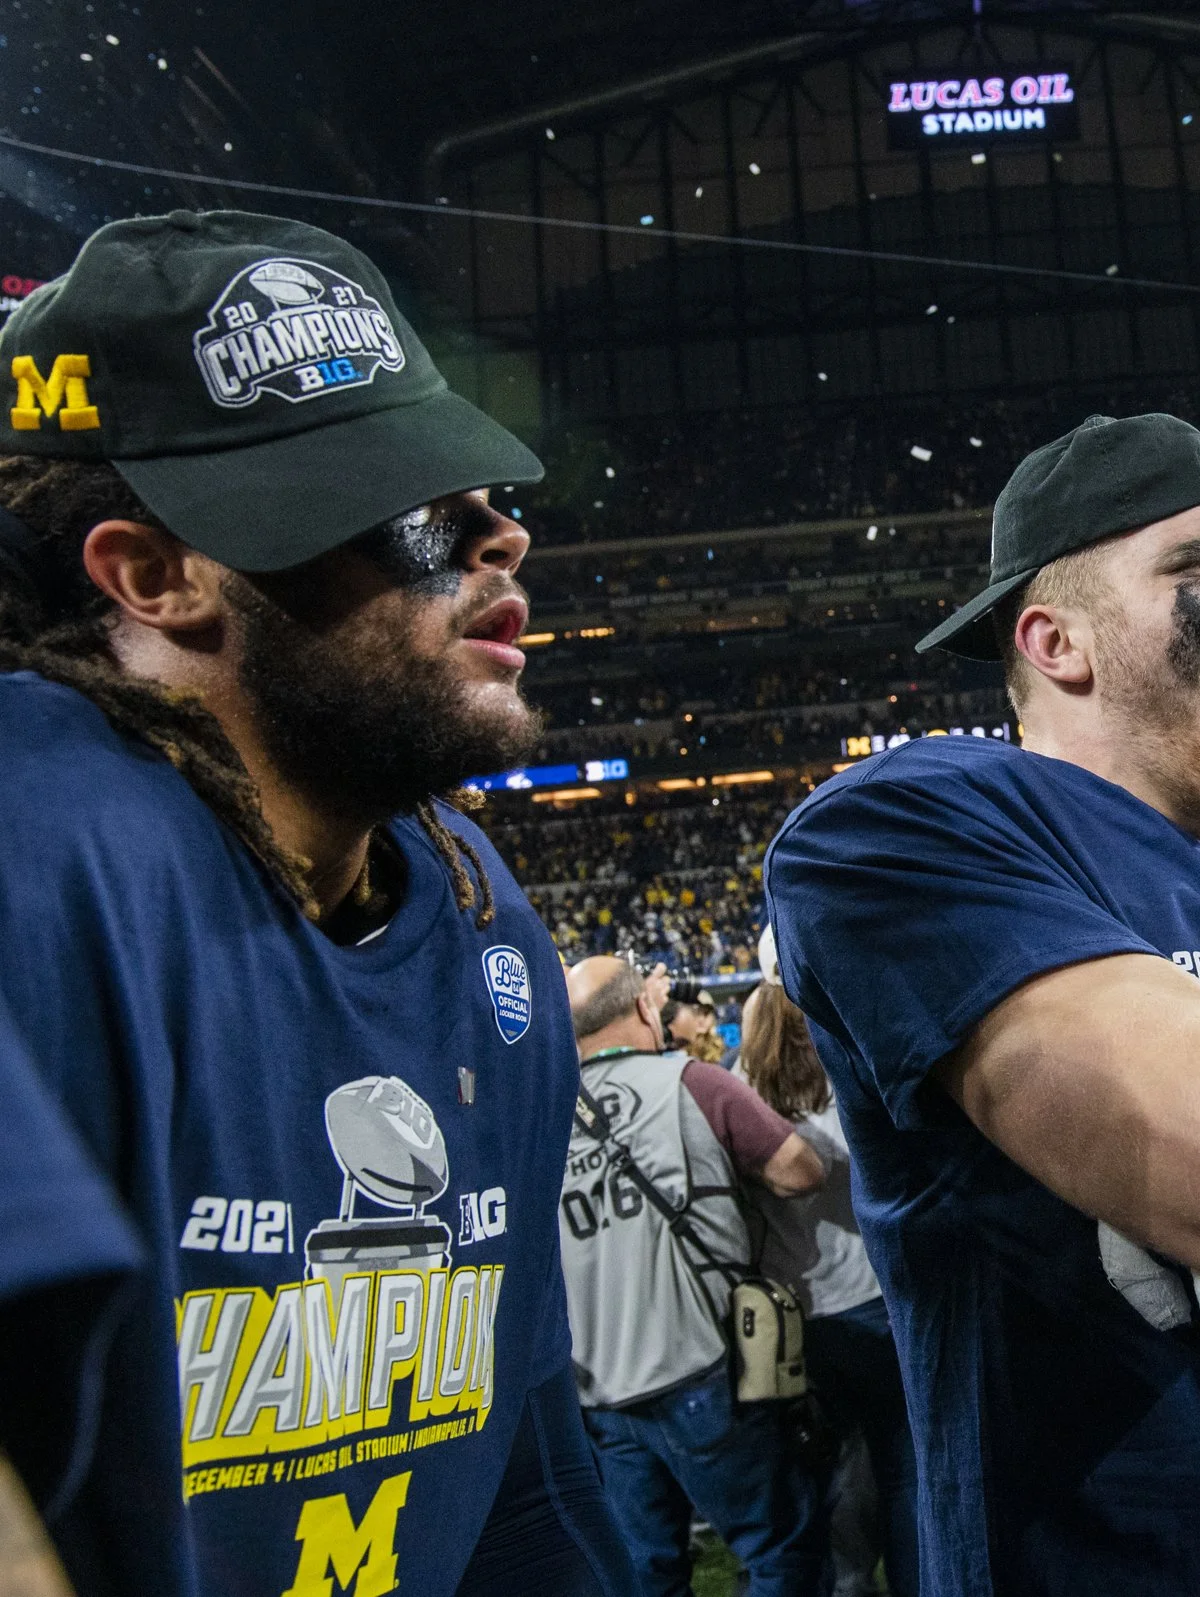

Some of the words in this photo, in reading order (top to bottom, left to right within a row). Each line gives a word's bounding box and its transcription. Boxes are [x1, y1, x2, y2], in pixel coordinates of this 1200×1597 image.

[888, 78, 1004, 112] LUCAS
[1011, 73, 1074, 104] OIL
[922, 108, 1046, 135] STADIUM
[223, 301, 258, 329] 20
[332, 286, 358, 306] 21
[206, 310, 399, 396] CHAMPIONS
[11, 354, 100, 430] M
[495, 955, 525, 987] Blue
[498, 995, 528, 1013] OFFICIAL
[180, 1195, 295, 1255] 2021
[176, 1265, 504, 1448] HAMPION
[272, 1461, 285, 1484] 4
[295, 1449, 337, 1481] LUCAS
[356, 1432, 409, 1463] STADIUM
[280, 1470, 413, 1597] M
